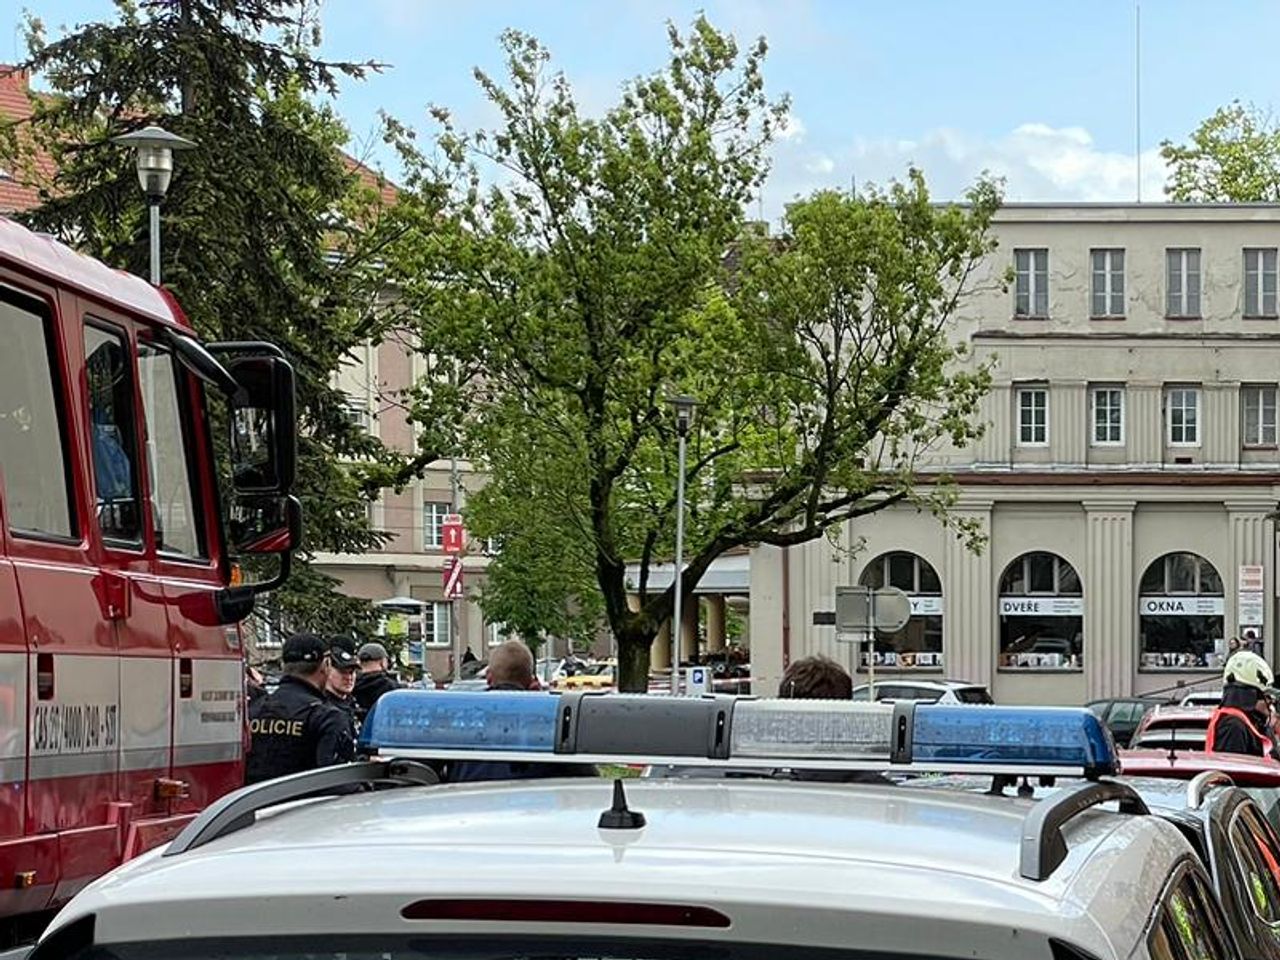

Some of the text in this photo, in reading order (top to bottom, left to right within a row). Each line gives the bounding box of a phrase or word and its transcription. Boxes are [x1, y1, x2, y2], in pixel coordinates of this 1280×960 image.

[1003, 600, 1040, 613] DVEŘE
[1147, 601, 1185, 612] OKNA
[250, 719, 304, 736] OLICIE
